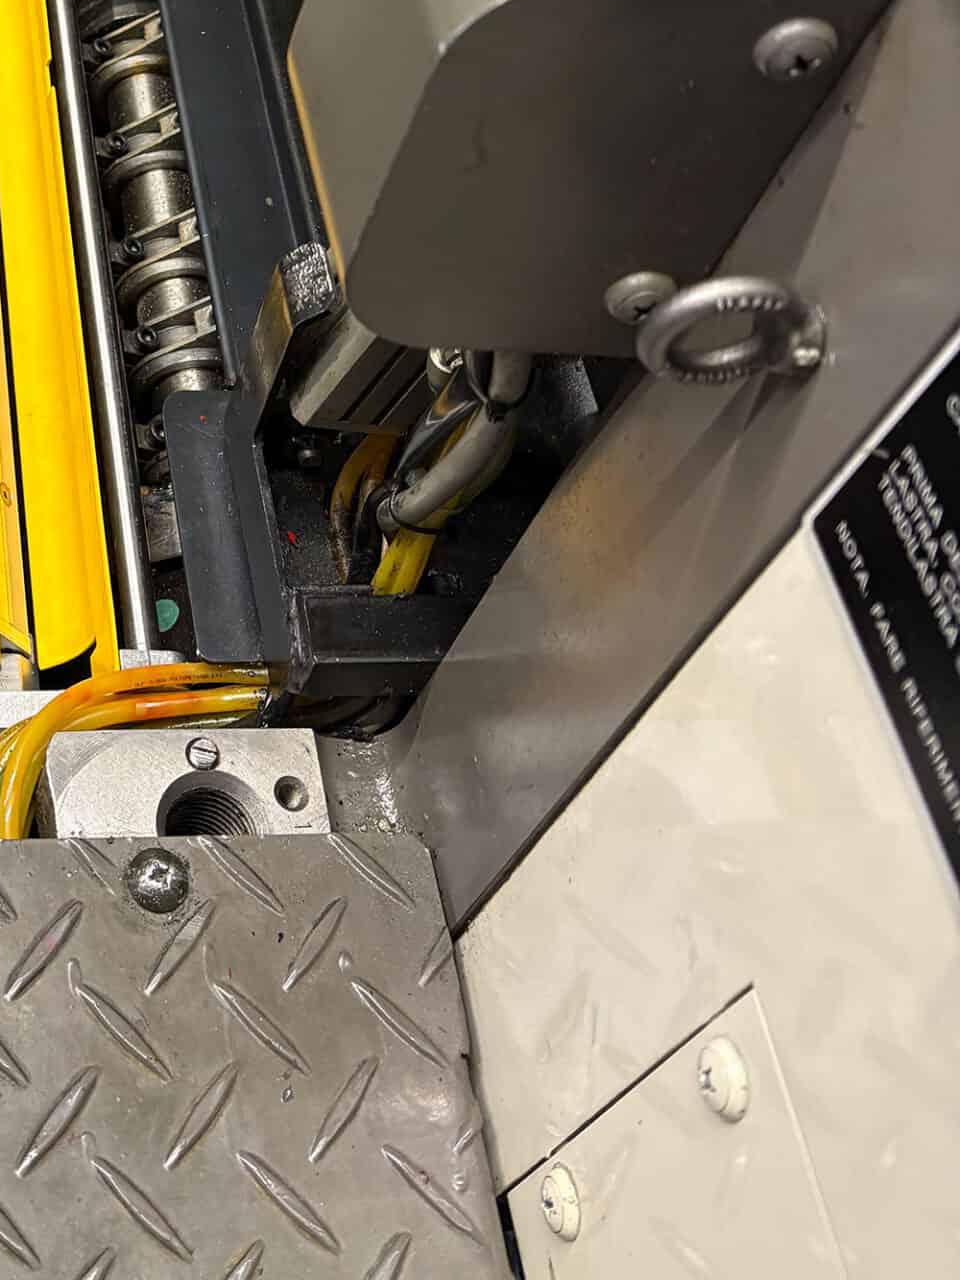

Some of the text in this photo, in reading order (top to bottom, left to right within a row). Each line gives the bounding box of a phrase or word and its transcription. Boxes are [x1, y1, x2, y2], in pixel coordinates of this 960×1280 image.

[879, 472, 959, 649] TENDILASTRA
[900, 443, 944, 529] PRIMA
[869, 601, 904, 672] FARE
[900, 676, 960, 827] RIFERIMEN
